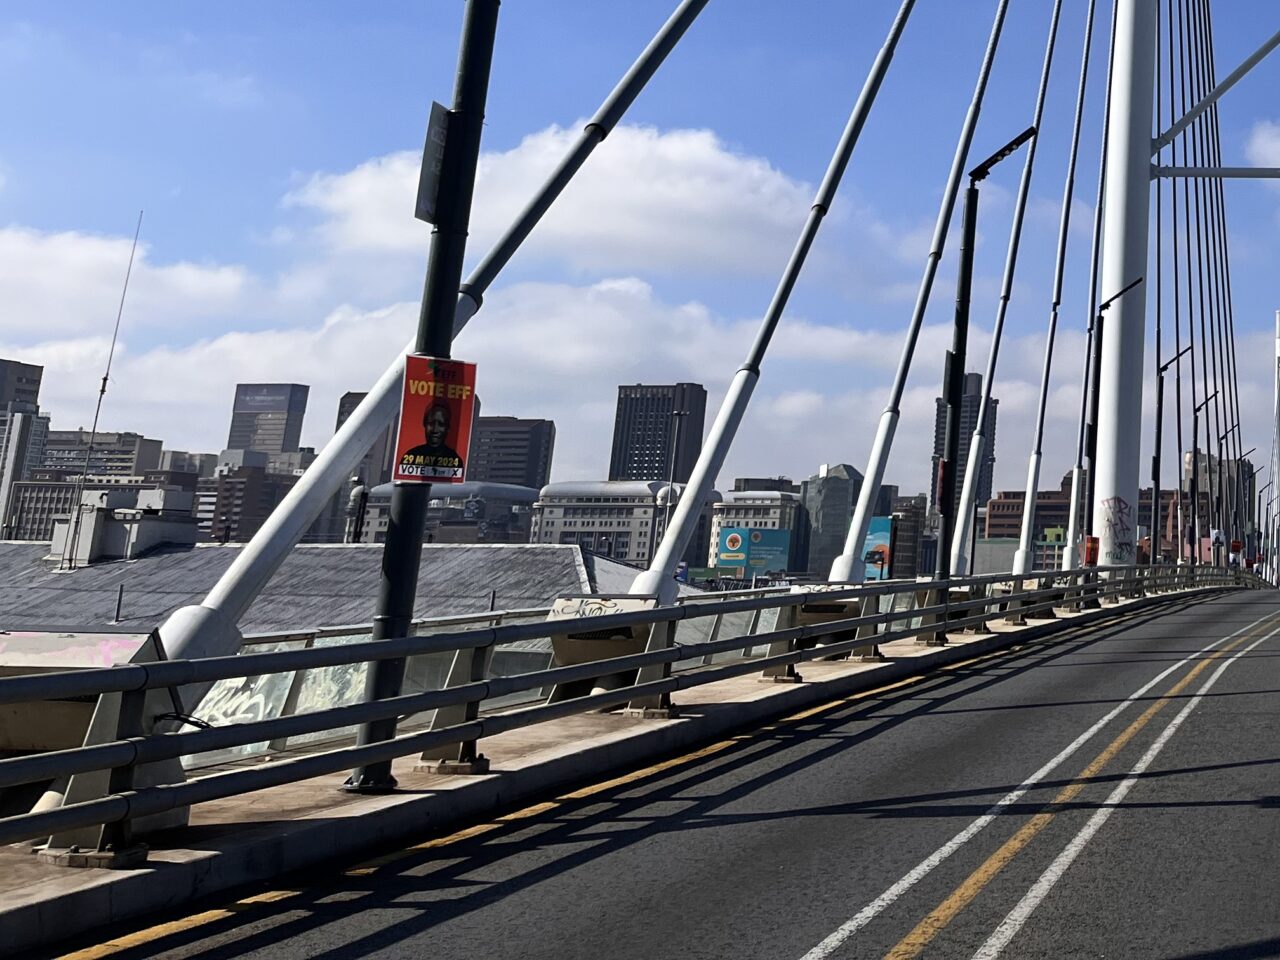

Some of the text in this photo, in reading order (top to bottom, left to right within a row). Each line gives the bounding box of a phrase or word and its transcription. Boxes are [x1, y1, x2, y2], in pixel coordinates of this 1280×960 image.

[409, 380, 471, 400] VOTE EFF
[403, 454, 459, 467] 29 MAY 2024
[402, 466, 426, 474] VOTE
